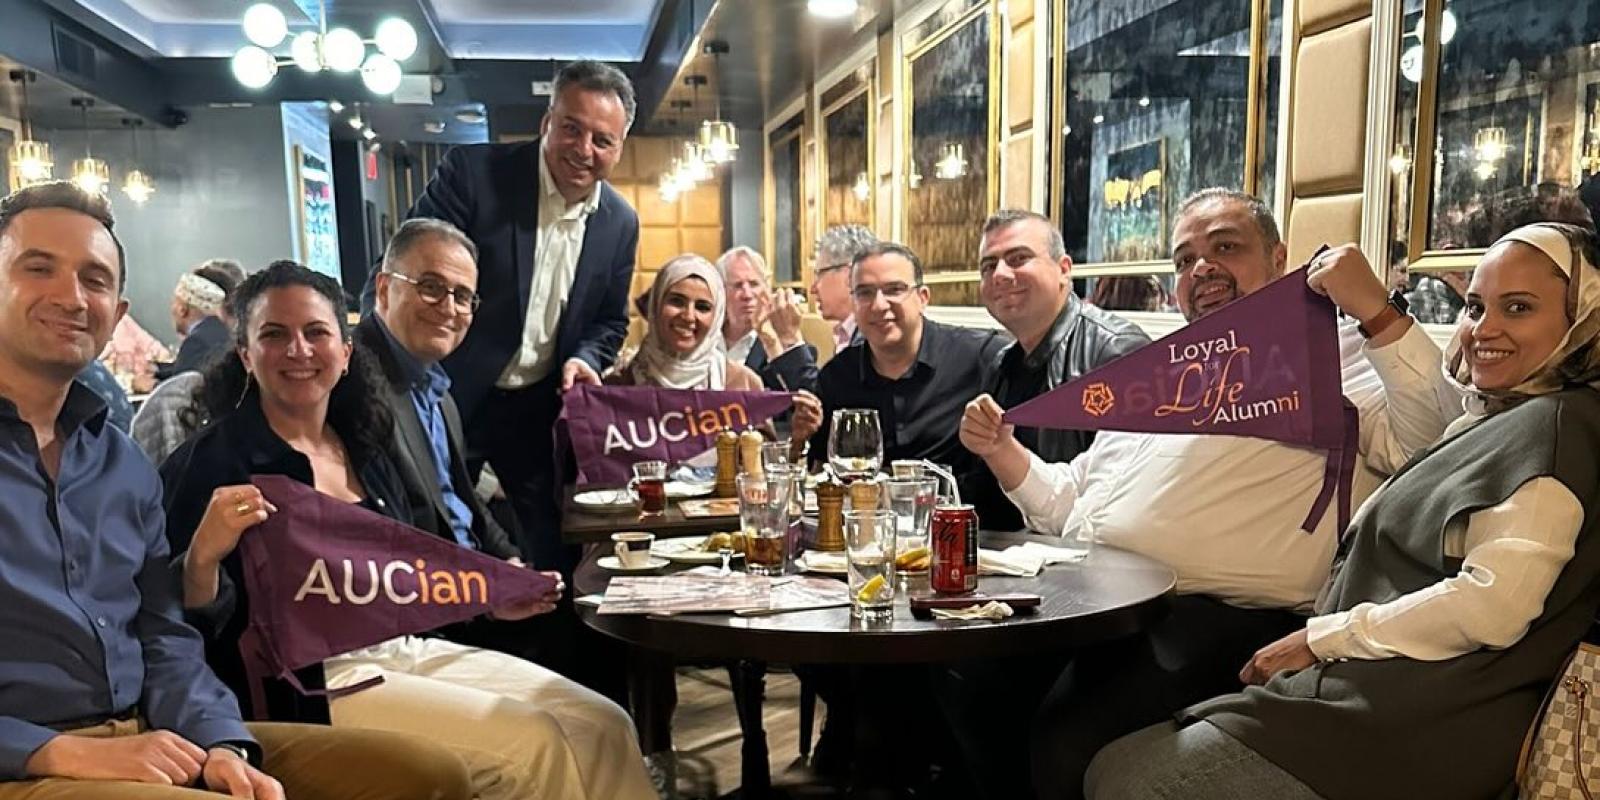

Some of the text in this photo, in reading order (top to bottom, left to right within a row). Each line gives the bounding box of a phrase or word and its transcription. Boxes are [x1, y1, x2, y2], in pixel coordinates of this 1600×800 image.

[1168, 330, 1238, 364] Loyal
[1154, 346, 1250, 426] Life
[1213, 391, 1300, 424] Alumni
[603, 402, 748, 455] AUCian
[294, 558, 488, 605] AUCian
